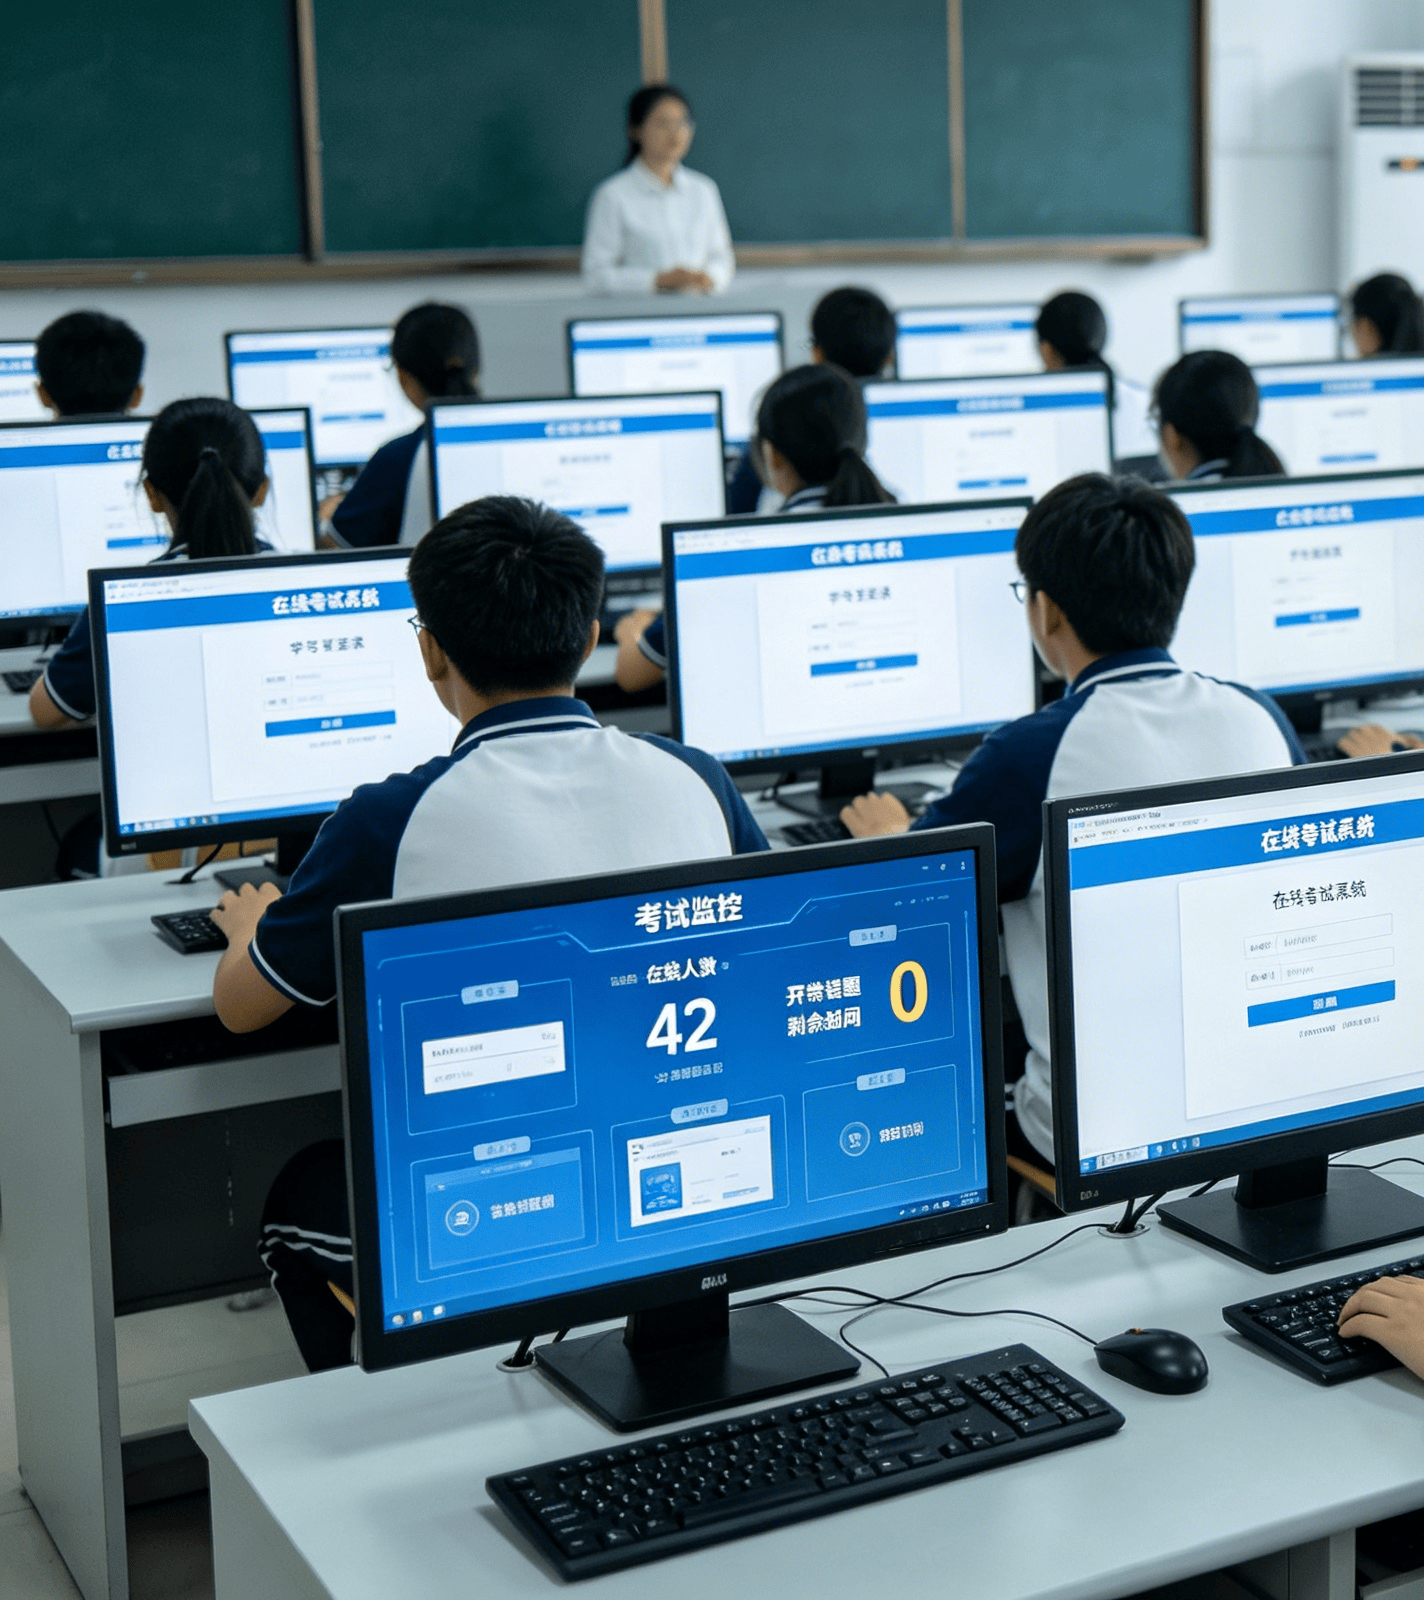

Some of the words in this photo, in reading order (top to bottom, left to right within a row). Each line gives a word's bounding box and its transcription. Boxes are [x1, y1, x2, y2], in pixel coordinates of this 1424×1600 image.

[635, 892, 743, 933] 考试监控
[890, 961, 928, 1023] 0
[646, 997, 718, 1055] 42
